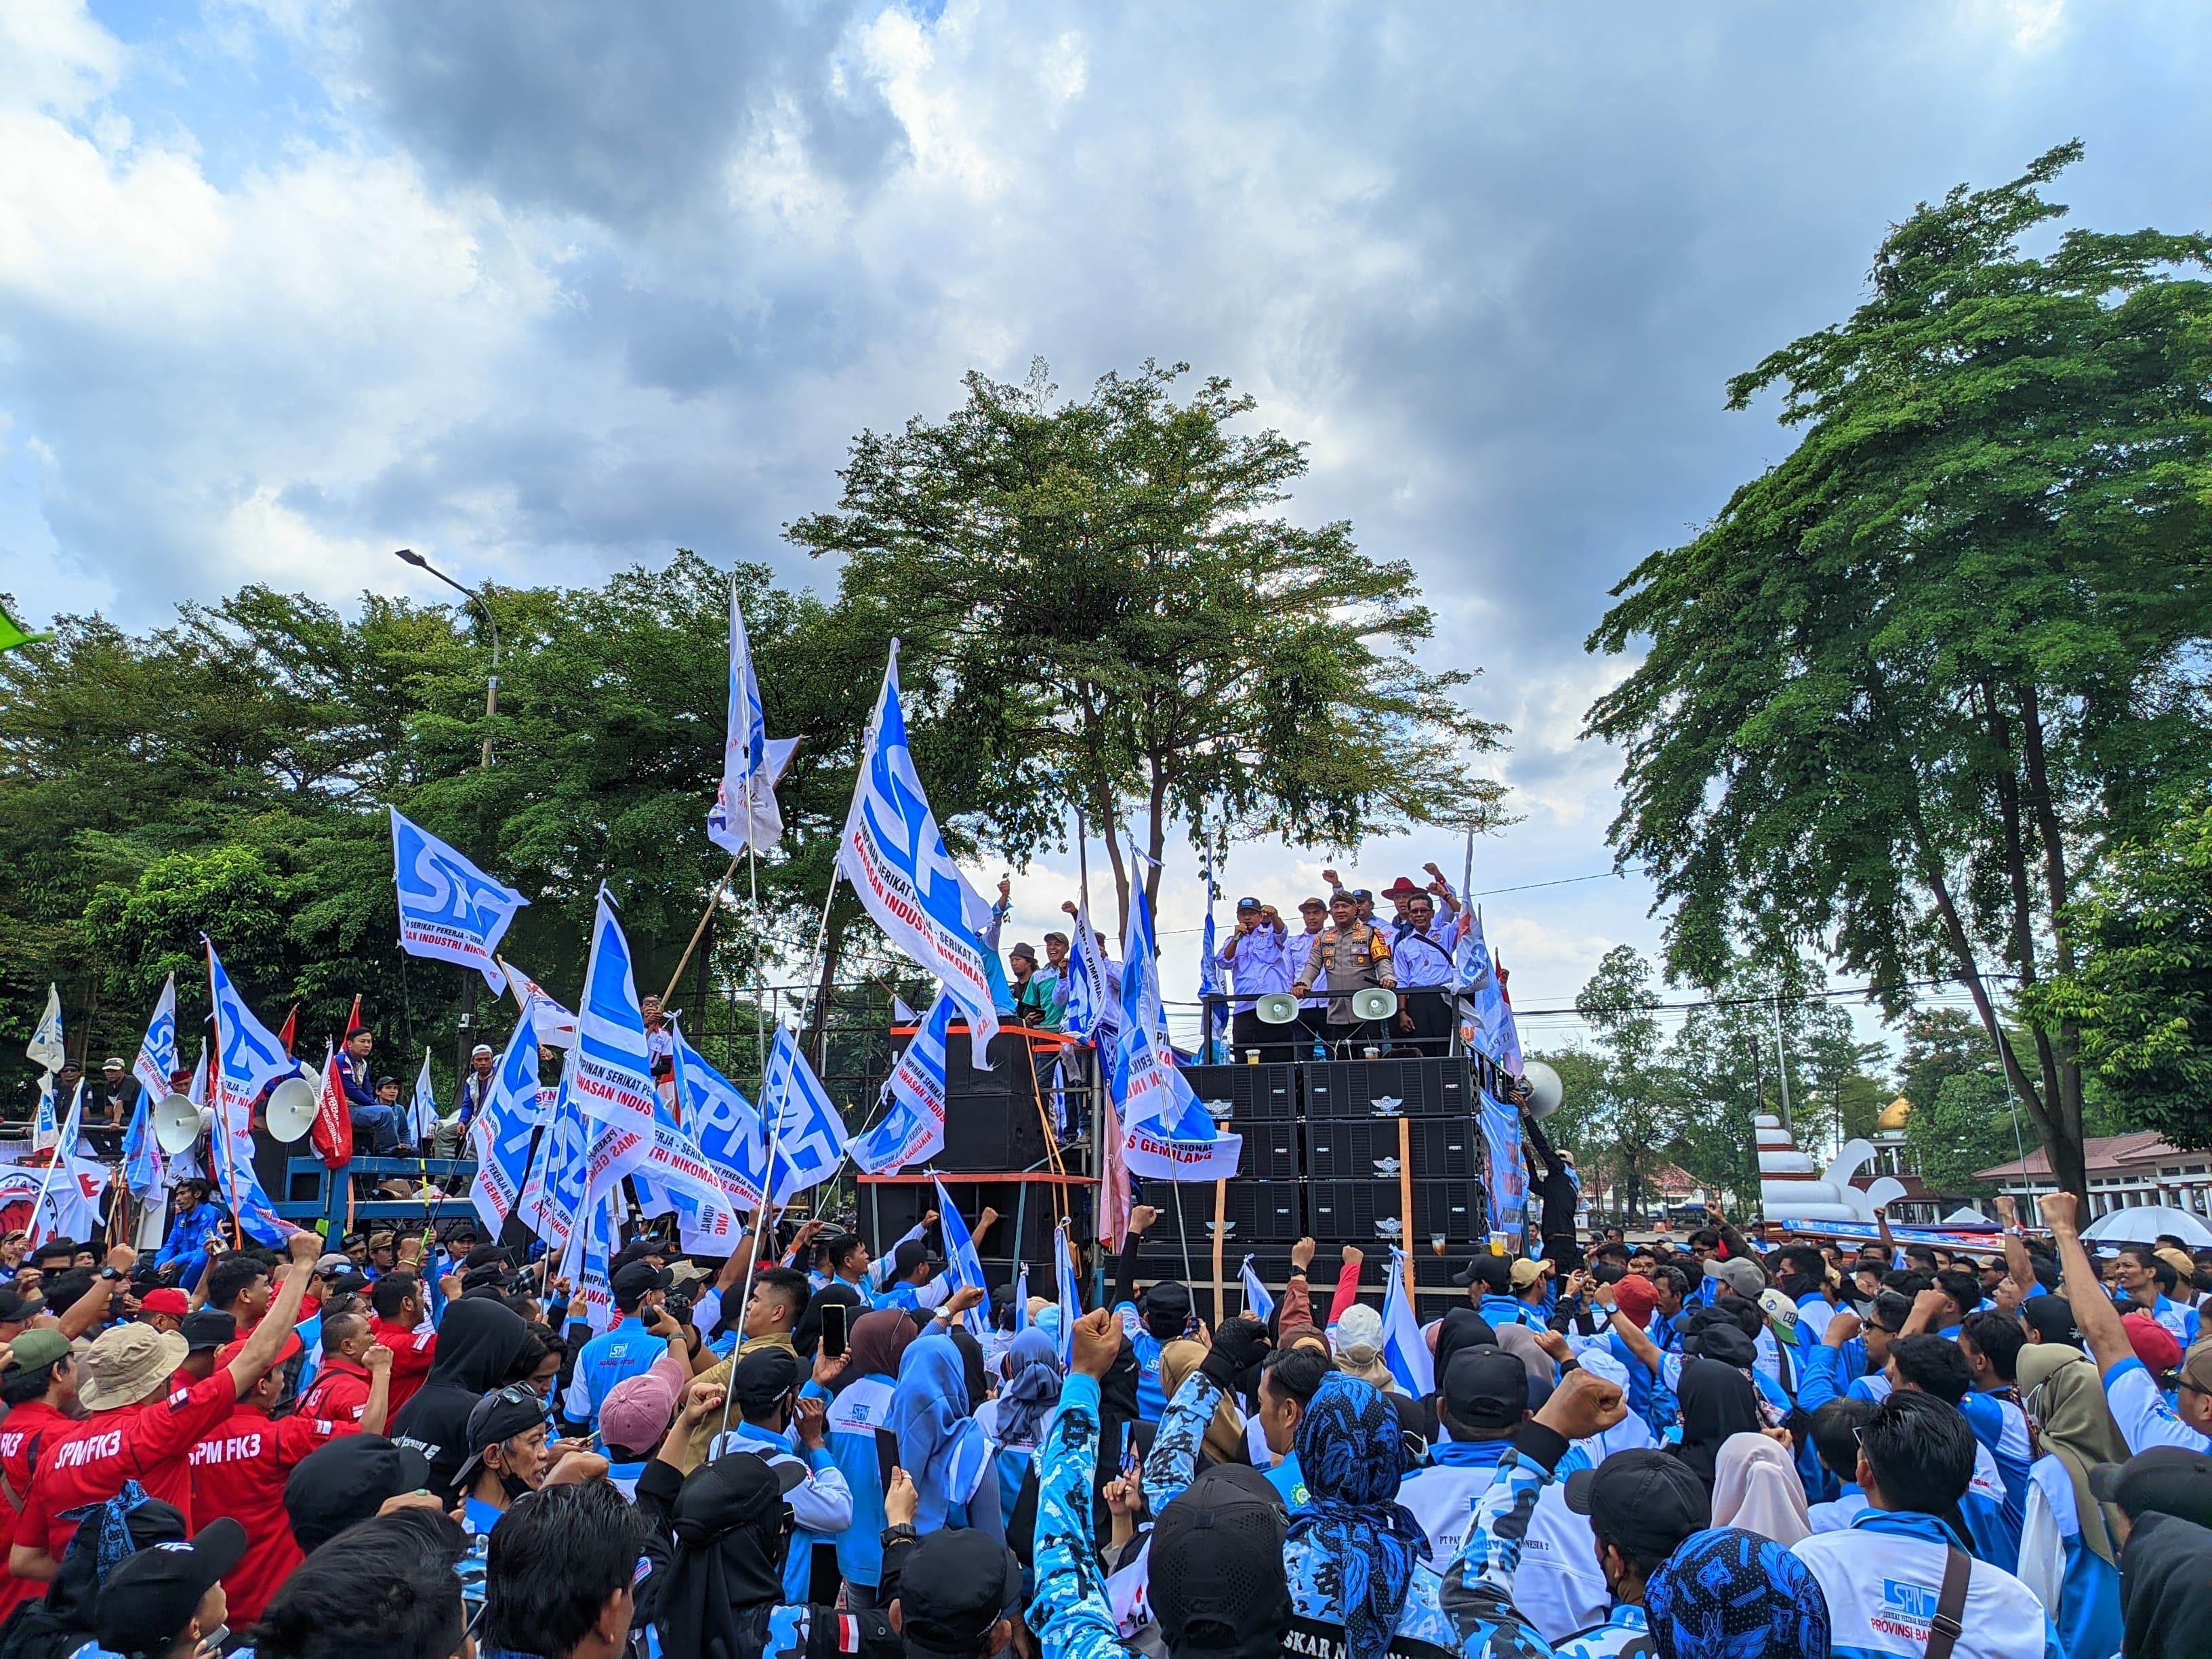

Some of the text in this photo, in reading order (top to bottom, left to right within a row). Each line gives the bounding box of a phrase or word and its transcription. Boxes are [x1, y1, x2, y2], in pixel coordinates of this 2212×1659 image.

[853, 832, 984, 989] KAWASAN INDUSTRI NIKOMAS
[878, 861, 912, 897] SERIKAT
[939, 930, 972, 959] SERIKAT
[410, 922, 435, 934] SERIKAT
[436, 927, 465, 939] PEKERJA
[419, 933, 462, 950] INDUSTRI
[606, 1069, 642, 1092] SERIKAT
[535, 1091, 558, 1104] SPN
[488, 1162, 506, 1189] PEKERJA
[670, 1154, 718, 1189] NIKOMAS
[722, 1168, 764, 1200] PEKERJA NASIO
[557, 1210, 573, 1227] SERIK
[853, 1404, 870, 1420] SPN
[54, 1429, 122, 1469] SPM FK3
[226, 1433, 261, 1462] FK3
[1439, 1536, 1448, 1544] PT
[1545, 1542, 1549, 1551] 2
[1884, 1582, 1936, 1616] SPN
[1871, 1618, 1913, 1639] PROVINSI
